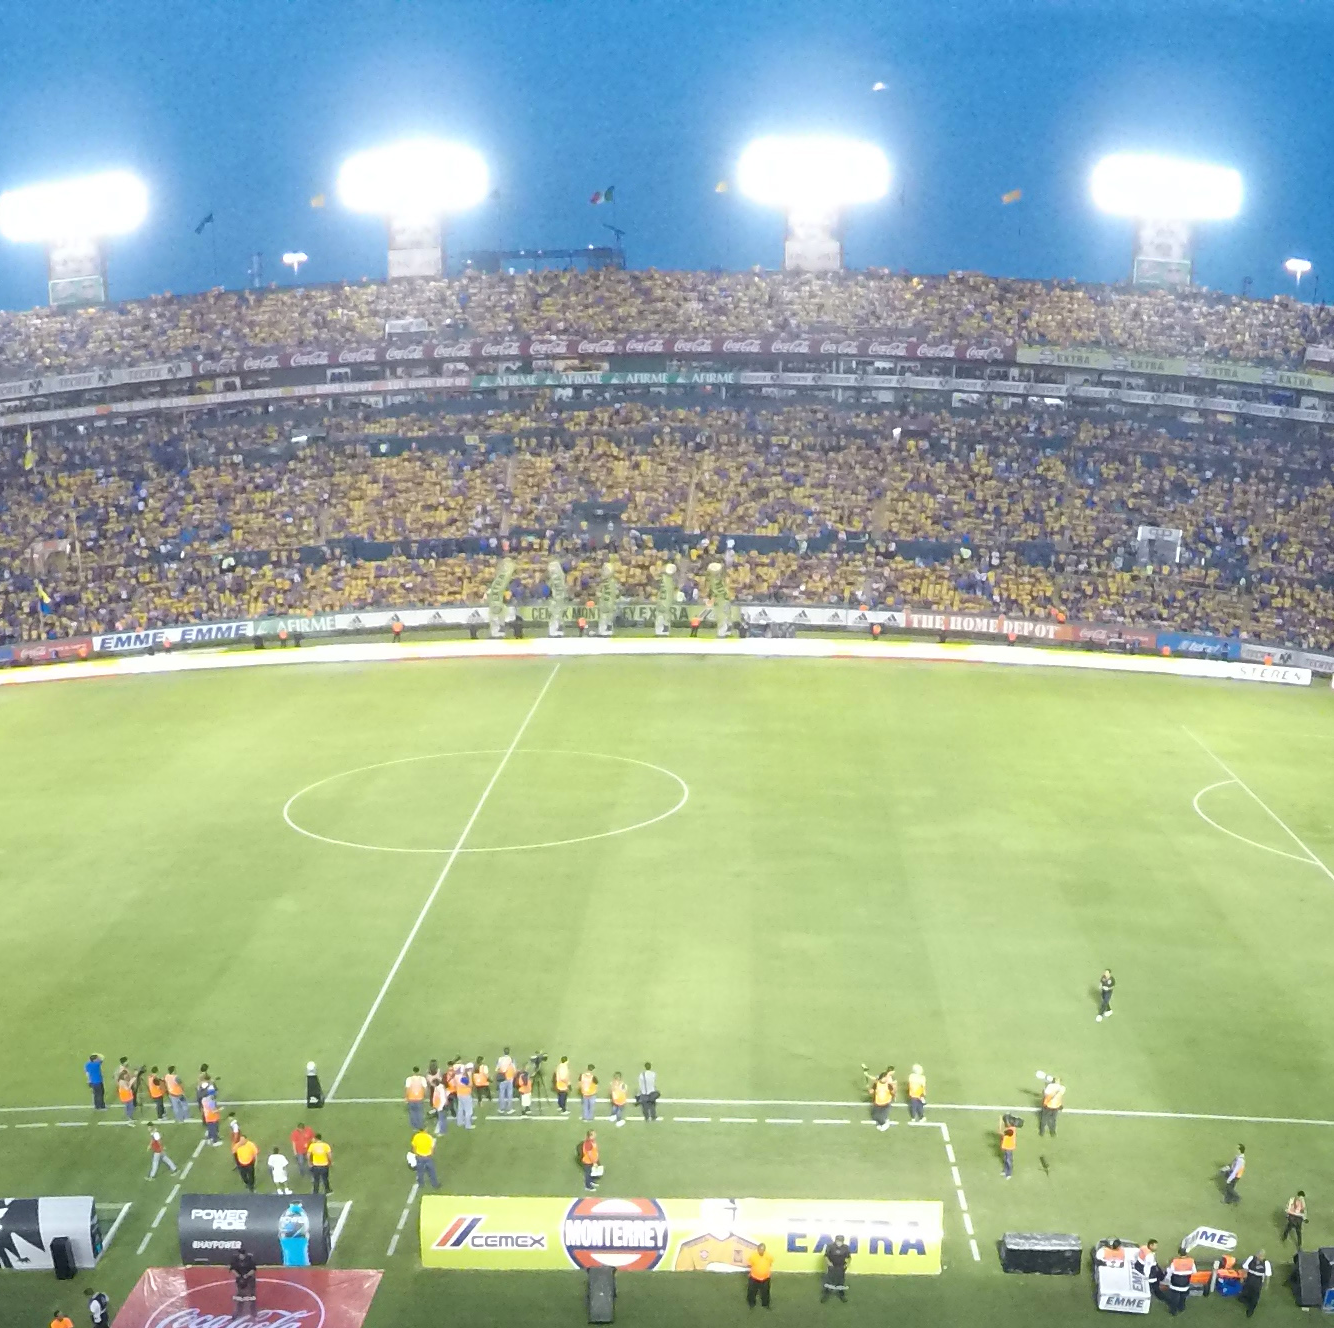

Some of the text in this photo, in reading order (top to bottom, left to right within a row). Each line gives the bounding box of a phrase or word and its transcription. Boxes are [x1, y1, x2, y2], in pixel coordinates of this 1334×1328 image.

[625, 373, 669, 384] AFIRME
[691, 373, 735, 384] AFIRME
[639, 605, 689, 620] EXRA
[179, 623, 248, 643] EMME
[276, 615, 336, 634] AFIRME
[910, 614, 1059, 639] THE HOME DEPOT
[99, 631, 165, 650] EMME
[191, 1209, 249, 1220] POWER
[469, 1219, 666, 1248] CEMEX MONTERREY
[1107, 1296, 1143, 1308] EMME
